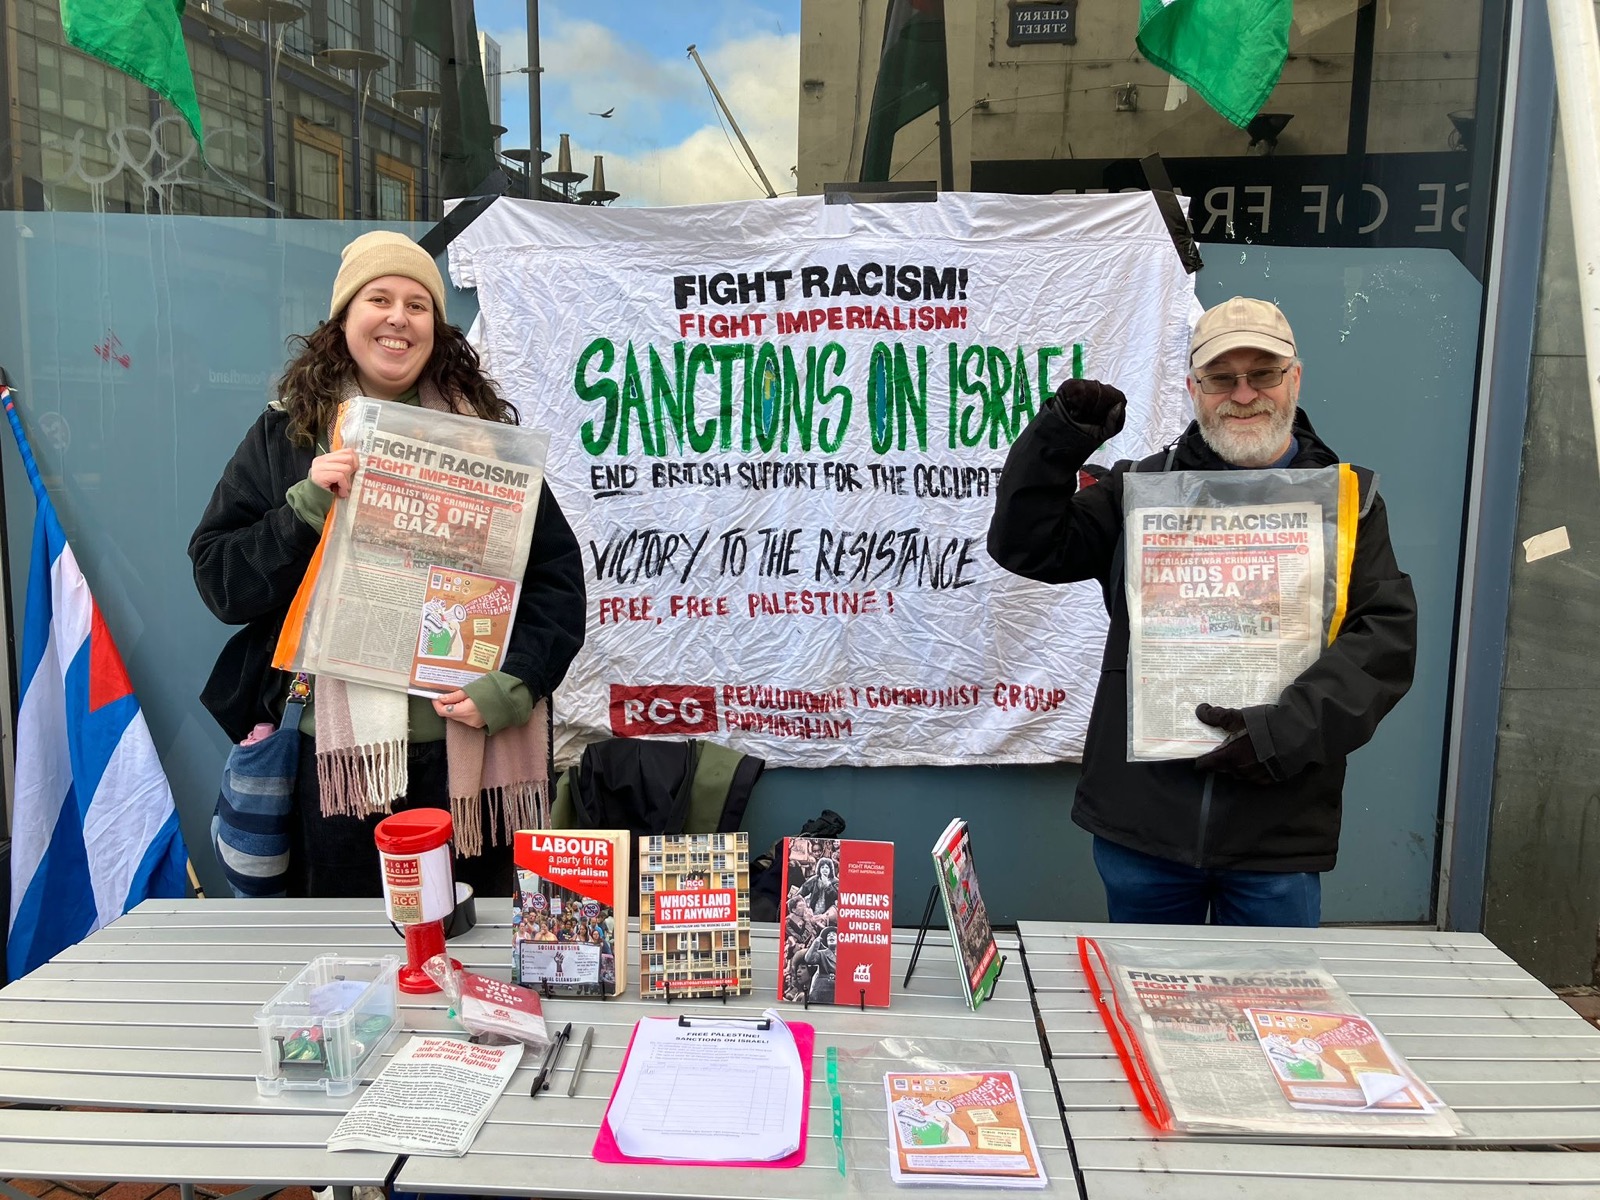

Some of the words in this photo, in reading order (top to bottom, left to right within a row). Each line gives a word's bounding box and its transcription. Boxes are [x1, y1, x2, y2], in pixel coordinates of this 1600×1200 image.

[674, 269, 792, 310] FIGHT
[801, 262, 968, 301] RACISM!
[679, 313, 767, 338] FIGHT
[776, 306, 968, 334] IMPERIALISM!
[574, 337, 853, 456] SANCTIONS
[867, 341, 927, 455] ON
[371, 437, 437, 467] FIGHT
[439, 453, 530, 489] RACISM!
[366, 455, 415, 477] FIGHT
[419, 467, 526, 503] IMPERIALISM!
[590, 464, 638, 490] END
[652, 462, 731, 488] BRITISH
[737, 462, 818, 490] SUPPORT
[823, 461, 863, 492] FOR
[867, 464, 909, 495] THE
[914, 464, 1003, 499] OCCUPAT
[364, 479, 421, 499] IMPERIALIST
[422, 492, 442, 504] WAR
[443, 497, 491, 514] CRIMINALS
[362, 488, 439, 520] HANDS
[447, 508, 489, 530] OFF
[393, 512, 451, 540] GAZA
[1142, 514, 1207, 531] FIGHT
[1211, 512, 1308, 531] RACISM!
[1142, 533, 1188, 546] FIGHT
[1193, 531, 1308, 546] IMPERIALISM!
[590, 528, 711, 584] VICTORY
[720, 527, 748, 577] TO
[758, 527, 802, 579] THE
[815, 527, 982, 590] RESISTANCE
[1144, 556, 1200, 566] IMPERIALIST
[1202, 556, 1222, 565] WAR
[1224, 555, 1276, 564] CRIMINALS
[1145, 566, 1223, 584] HANDS
[1231, 564, 1275, 582] OFF
[1179, 582, 1241, 599] GAZA
[599, 595, 662, 626] FREE,
[670, 594, 731, 619] FREE
[624, 697, 705, 726] RCG
[723, 684, 859, 714] REVOLUTIONARY
[865, 684, 984, 709] COMMUNIST
[993, 682, 1066, 711] GROUP
[724, 710, 853, 740] BIRMINGHAM
[531, 836, 608, 856] LABOUR
[548, 855, 554, 863] a
[556, 856, 580, 867] party
[583, 855, 592, 865] fit
[595, 856, 608, 866] for
[548, 865, 609, 878] imperialism
[393, 896, 417, 906] RCG
[660, 894, 700, 908] WHOSE
[703, 893, 731, 906] LAND
[840, 893, 890, 907] WOMEN'S
[661, 908, 671, 920] IS
[673, 908, 682, 920] IT
[684, 907, 731, 919] ANYWAY?
[839, 908, 890, 920] OPPRESSION
[848, 922, 881, 931] UNDER
[838, 932, 888, 944] CAPITALISM
[477, 976, 517, 992] WHAT
[1127, 971, 1204, 984] FIGHT
[1210, 975, 1323, 988] RACISM!
[1132, 980, 1188, 990] FIGHT
[475, 986, 523, 1003] STAND
[488, 984, 509, 994] WE
[485, 994, 514, 1005] FOR
[442, 1040, 468, 1050] Party:
[444, 1054, 460, 1062] out
[460, 1056, 497, 1071] fighting
[469, 1053, 501, 1063] Sultana
